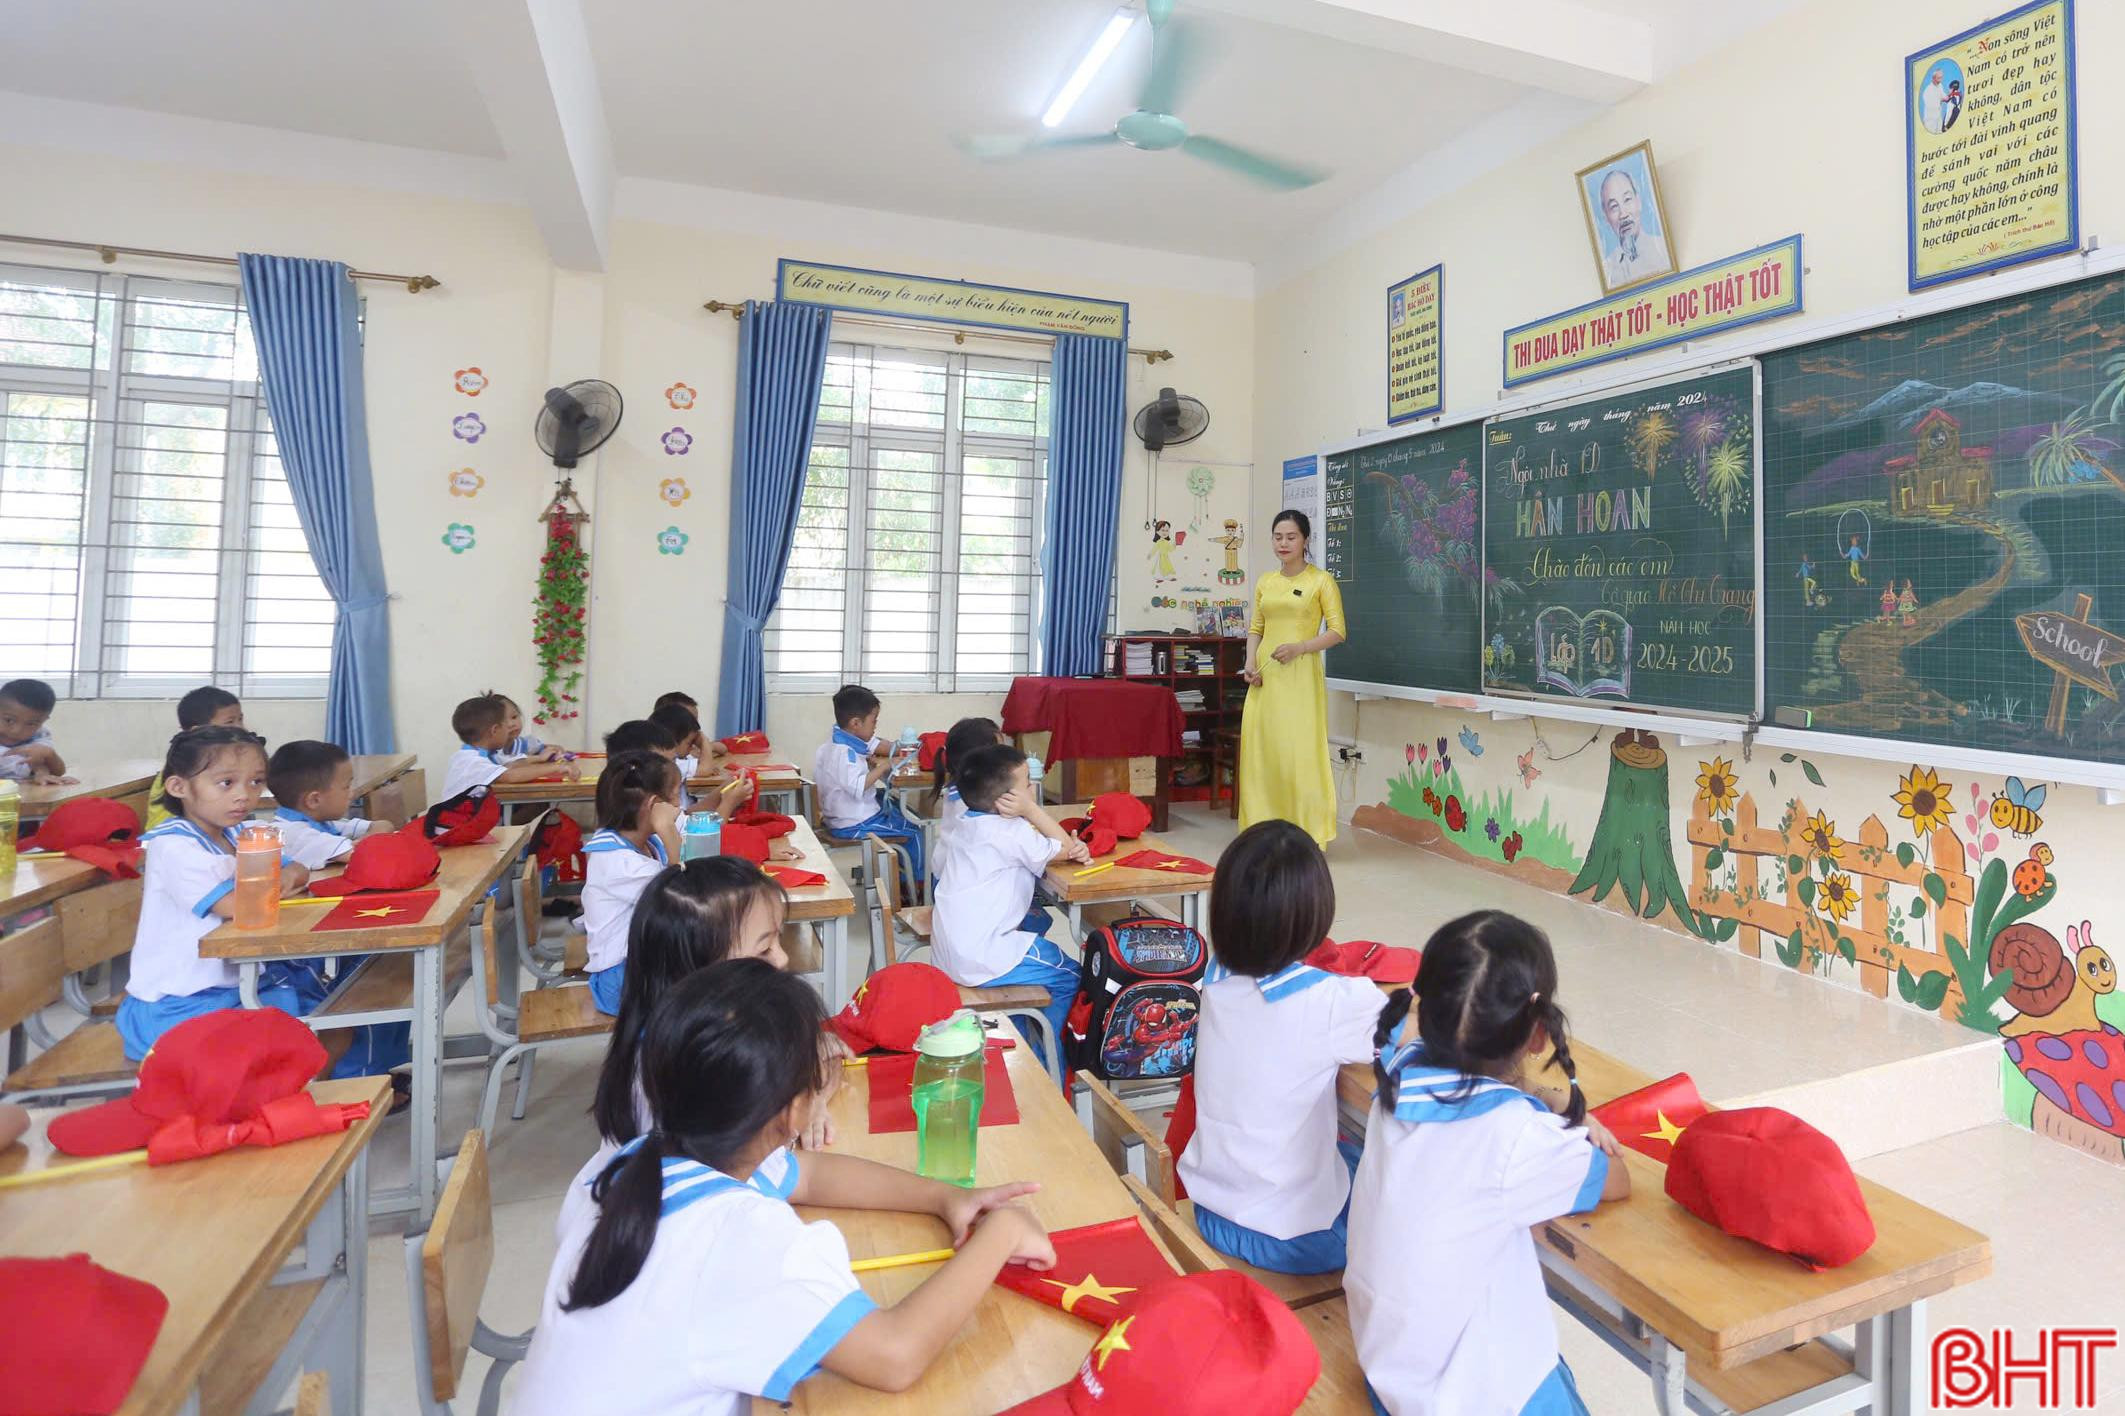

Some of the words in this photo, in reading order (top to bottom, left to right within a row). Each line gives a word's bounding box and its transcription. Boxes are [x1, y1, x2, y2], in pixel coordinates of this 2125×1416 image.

[2004, 27, 2030, 45] sông
[2033, 14, 2056, 32] Việt
[1967, 60, 1991, 77] Nam
[1995, 51, 2007, 66] có
[2012, 43, 2030, 59] trở
[2034, 34, 2056, 50] nên
[1967, 74, 1994, 95] tươi
[2002, 65, 2024, 81] đẹp
[2033, 53, 2056, 69] hay
[1967, 92, 2002, 112] không,
[2010, 80, 2031, 96] dân
[2040, 70, 2057, 86] tộc
[1969, 111, 1994, 128] Việt
[2003, 98, 2032, 117] Nam
[2042, 86, 2057, 102] có
[1921, 146, 1949, 164] bước
[1951, 138, 1967, 154] tới
[1970, 132, 1987, 147] đài
[1991, 120, 2016, 139] vinh
[2019, 107, 2058, 131] quang
[1921, 164, 1936, 180] để
[1942, 155, 1970, 174] sánh
[1979, 144, 1998, 161] vai
[2006, 134, 2027, 151] với
[2036, 125, 2059, 142] các
[1921, 179, 1956, 197] cường
[1962, 164, 1989, 186] quốc
[1995, 158, 2021, 173] năm
[2029, 145, 2058, 163] châu
[1922, 198, 1951, 214] được
[1950, 191, 1971, 206] hay
[1972, 180, 2010, 199] không,
[2012, 166, 2044, 187] chính
[2046, 162, 2058, 176] là
[1922, 217, 1943, 232] nhờ
[1945, 210, 1967, 225] một
[1967, 201, 1995, 221] phần
[1998, 194, 2017, 209] lớn
[2019, 189, 2029, 203] ở
[2030, 183, 2059, 200] công
[1922, 236, 1942, 249] học
[1942, 230, 1960, 245] tập
[1960, 223, 1980, 238] của
[1981, 218, 2000, 232] các
[792, 271, 824, 289] Chữ
[826, 280, 856, 293] viết
[858, 285, 892, 301] cũng
[895, 285, 910, 300] là
[914, 293, 945, 306] một
[945, 296, 963, 309] sự
[965, 293, 994, 310] biểu
[997, 298, 1026, 317] hiện
[1030, 306, 1053, 318] của
[1056, 309, 1081, 320] nết
[1080, 314, 1119, 327] người
[1513, 340, 1532, 369] THI
[1534, 332, 1558, 364] ĐUA
[1562, 323, 1587, 357] DẠY
[1590, 310, 1623, 348] THẬT
[1626, 298, 1653, 337] TỐT
[1667, 288, 1698, 328] HỌC
[1703, 273, 1745, 315] THẬT
[1749, 257, 1782, 301] TỐT
[1535, 418, 1557, 434] Thứ
[1568, 417, 1592, 432] ngày
[1603, 408, 1632, 423] tháng
[1647, 401, 1671, 414] năm
[1539, 447, 1568, 480] nhà
[1332, 491, 1337, 501] V
[1340, 490, 1345, 499] S
[1516, 490, 1563, 538] HÂN
[1577, 486, 1651, 534] HOAN
[1529, 547, 1570, 586] Chào
[1574, 546, 1605, 577] đón
[1608, 556, 1634, 576] các
[1550, 633, 1576, 675] Lớp
[1590, 635, 1615, 666] 1D
[2033, 616, 2108, 669] School
